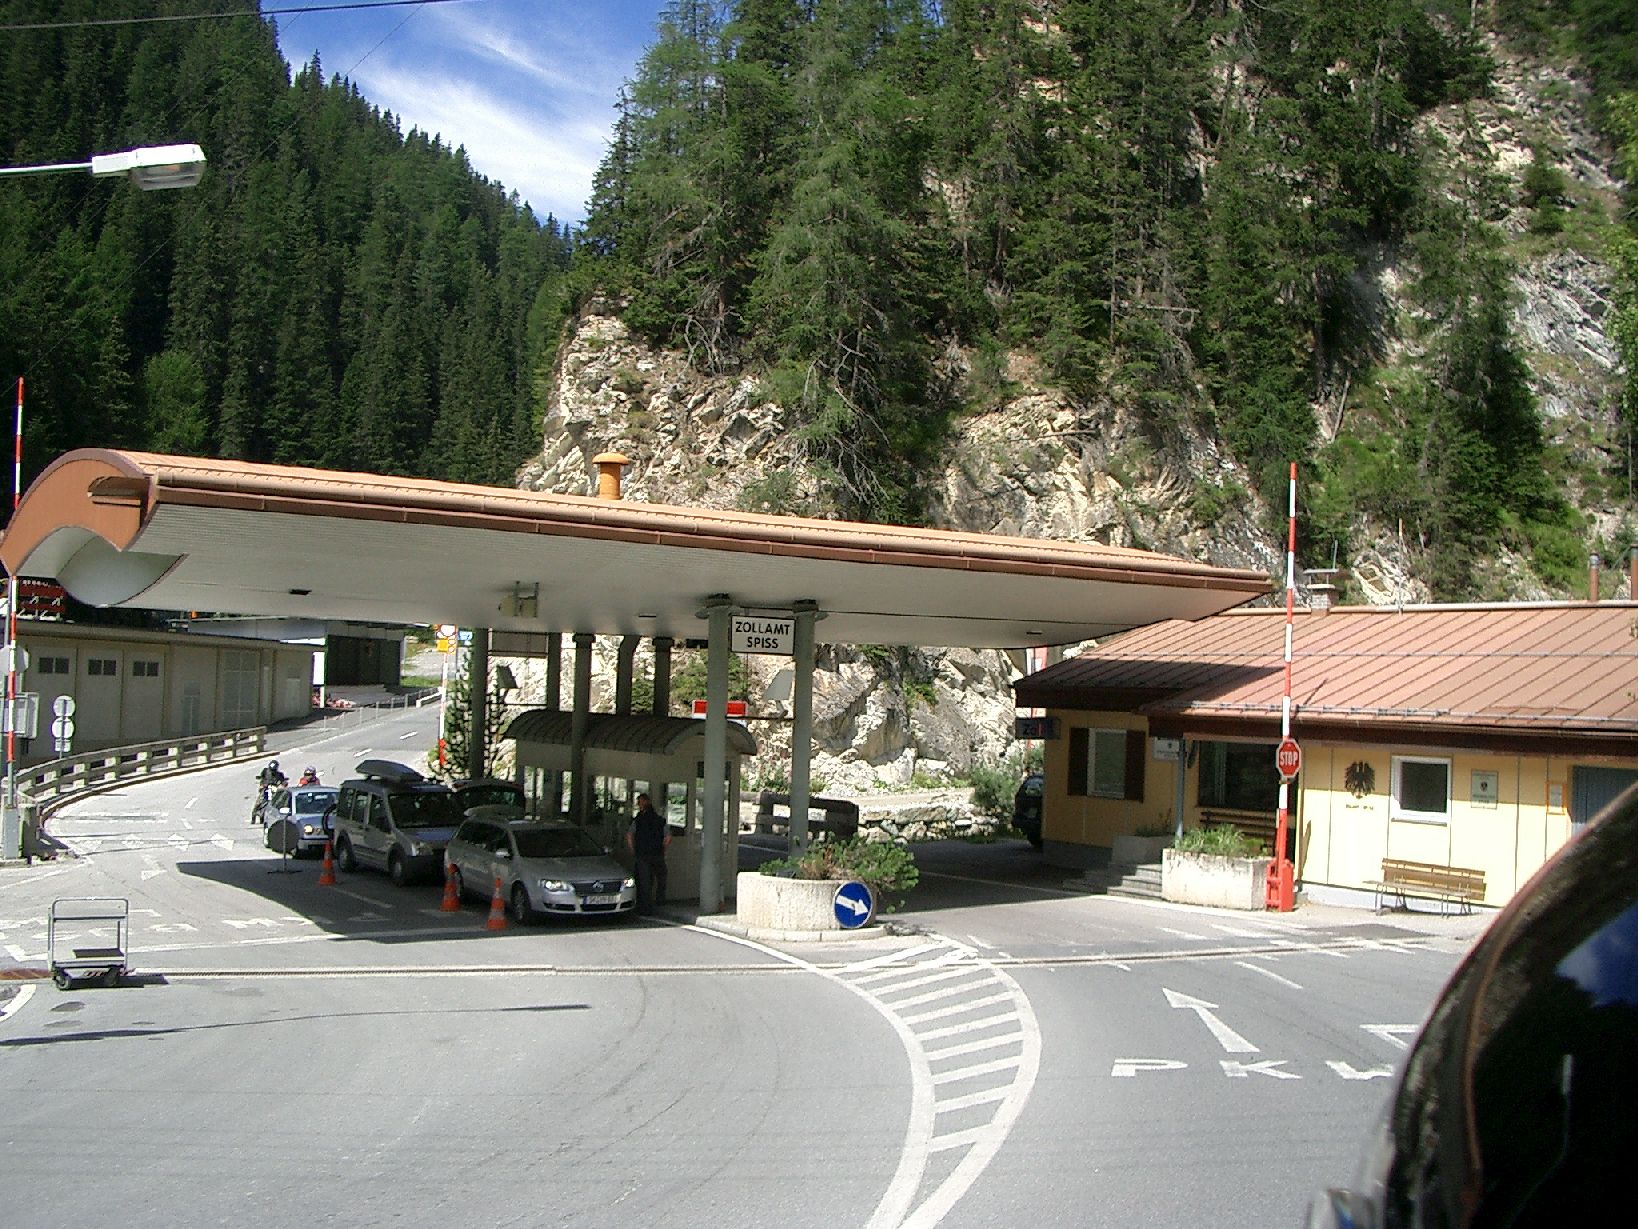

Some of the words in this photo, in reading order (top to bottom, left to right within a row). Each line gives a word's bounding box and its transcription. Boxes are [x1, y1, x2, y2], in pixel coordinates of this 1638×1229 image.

[735, 621, 791, 636] ZOLLAMT
[746, 636, 779, 649] SPISS
[1279, 751, 1299, 766] STOP
